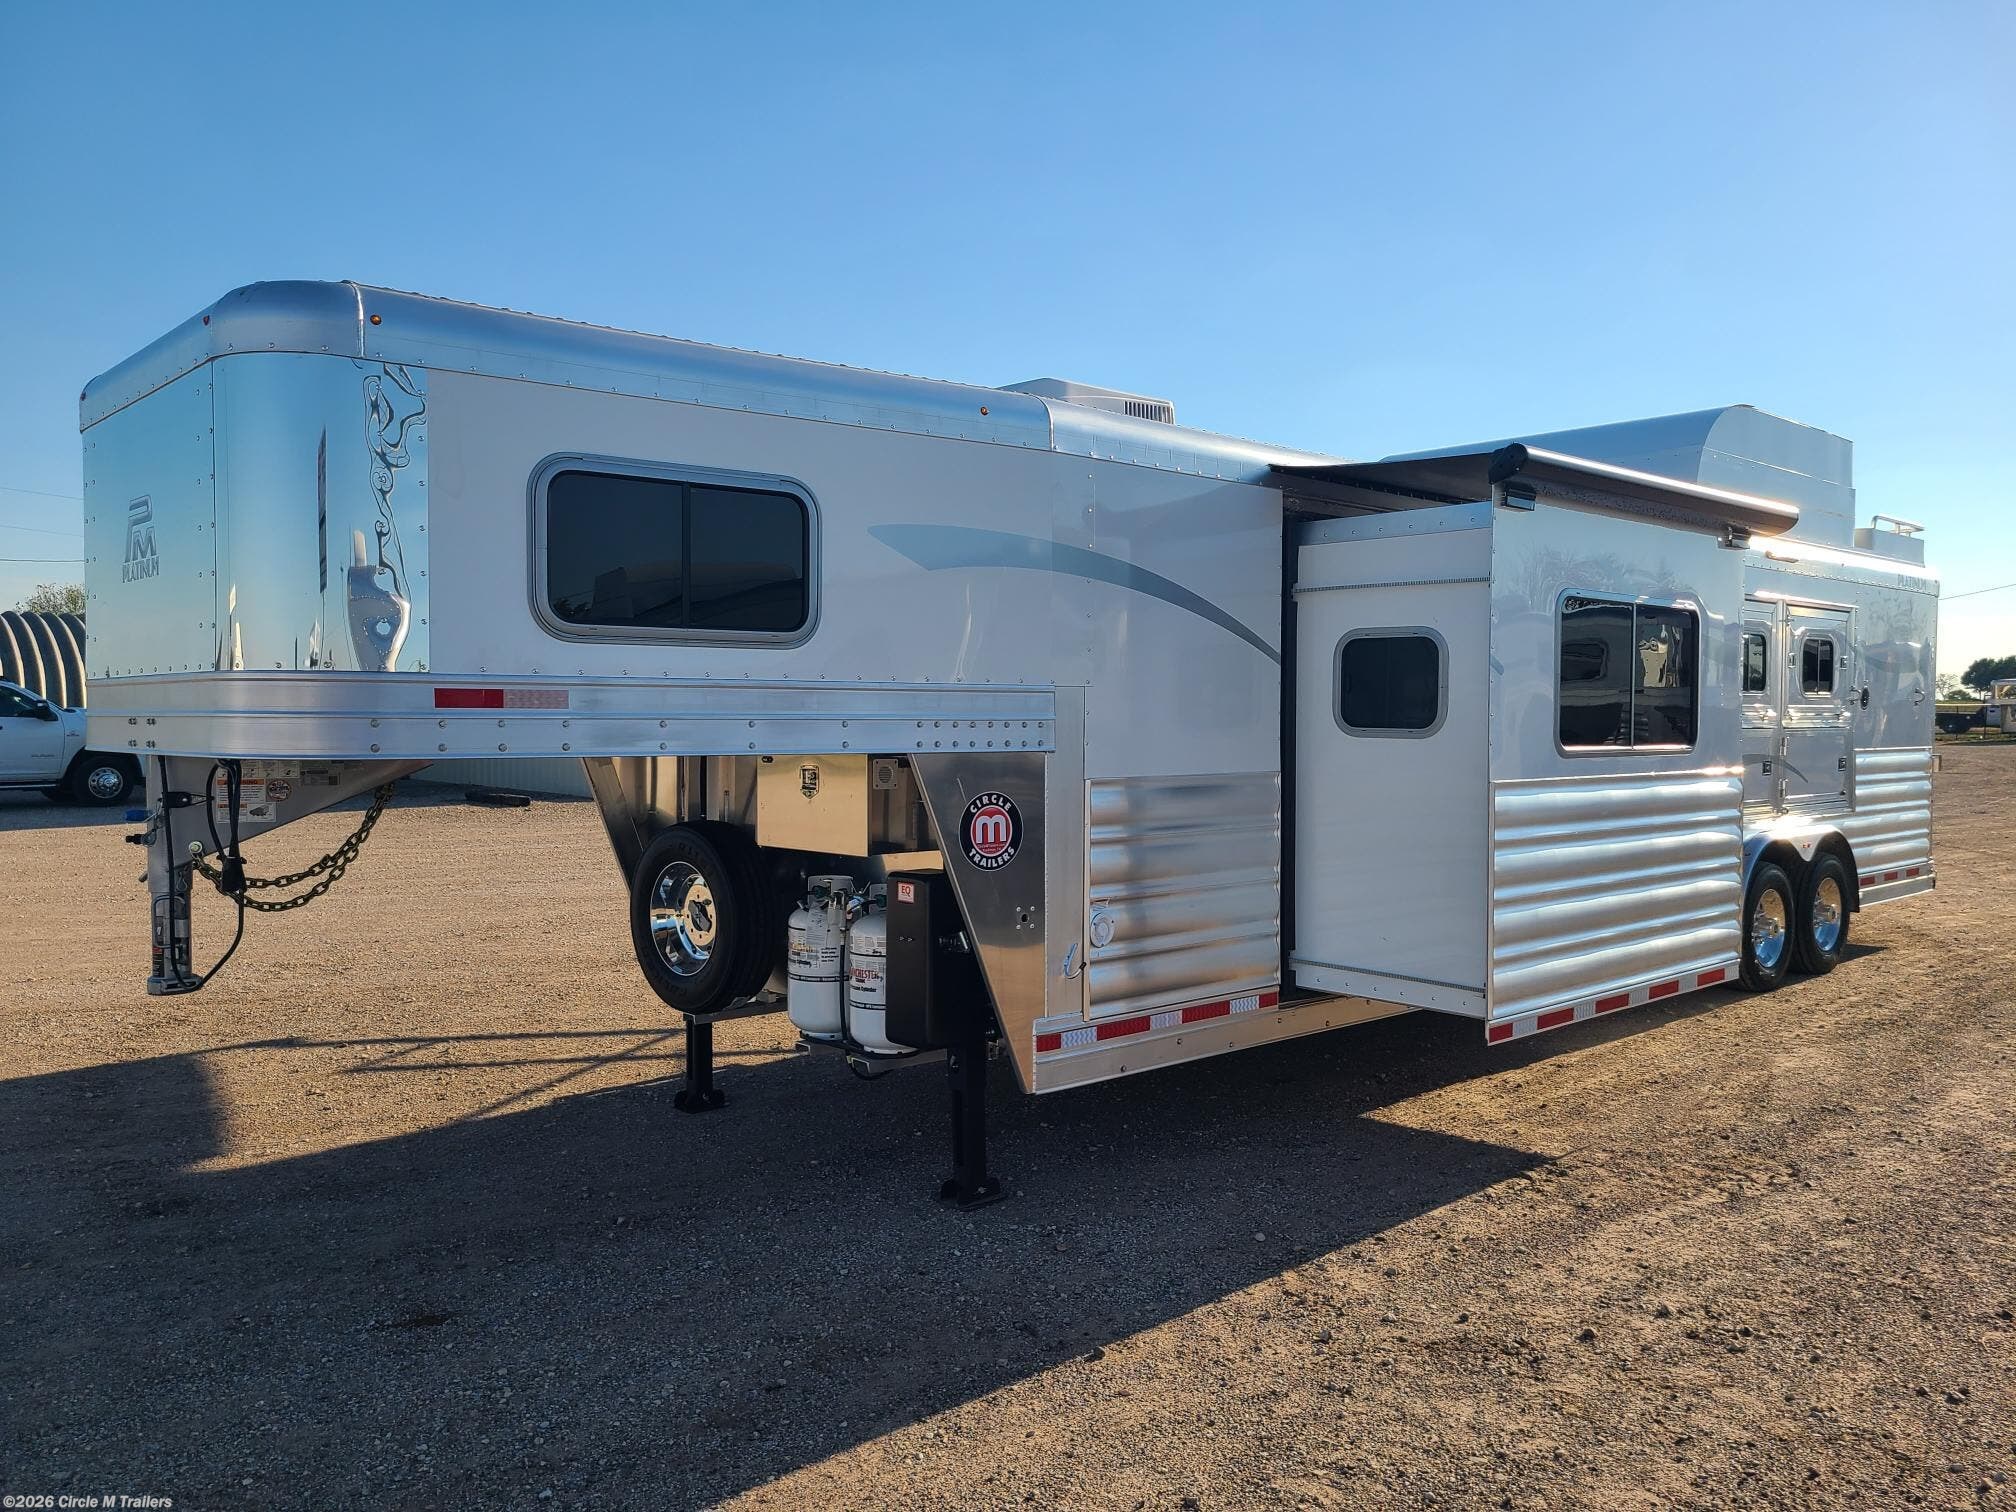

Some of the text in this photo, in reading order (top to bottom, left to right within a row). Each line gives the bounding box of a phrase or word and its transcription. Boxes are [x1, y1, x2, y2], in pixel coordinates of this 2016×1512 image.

[122, 556, 160, 584] PLATINUM
[970, 794, 1012, 813] CIRCLE
[969, 846, 1015, 868] TRAILERS
[901, 885, 912, 897] EQ
